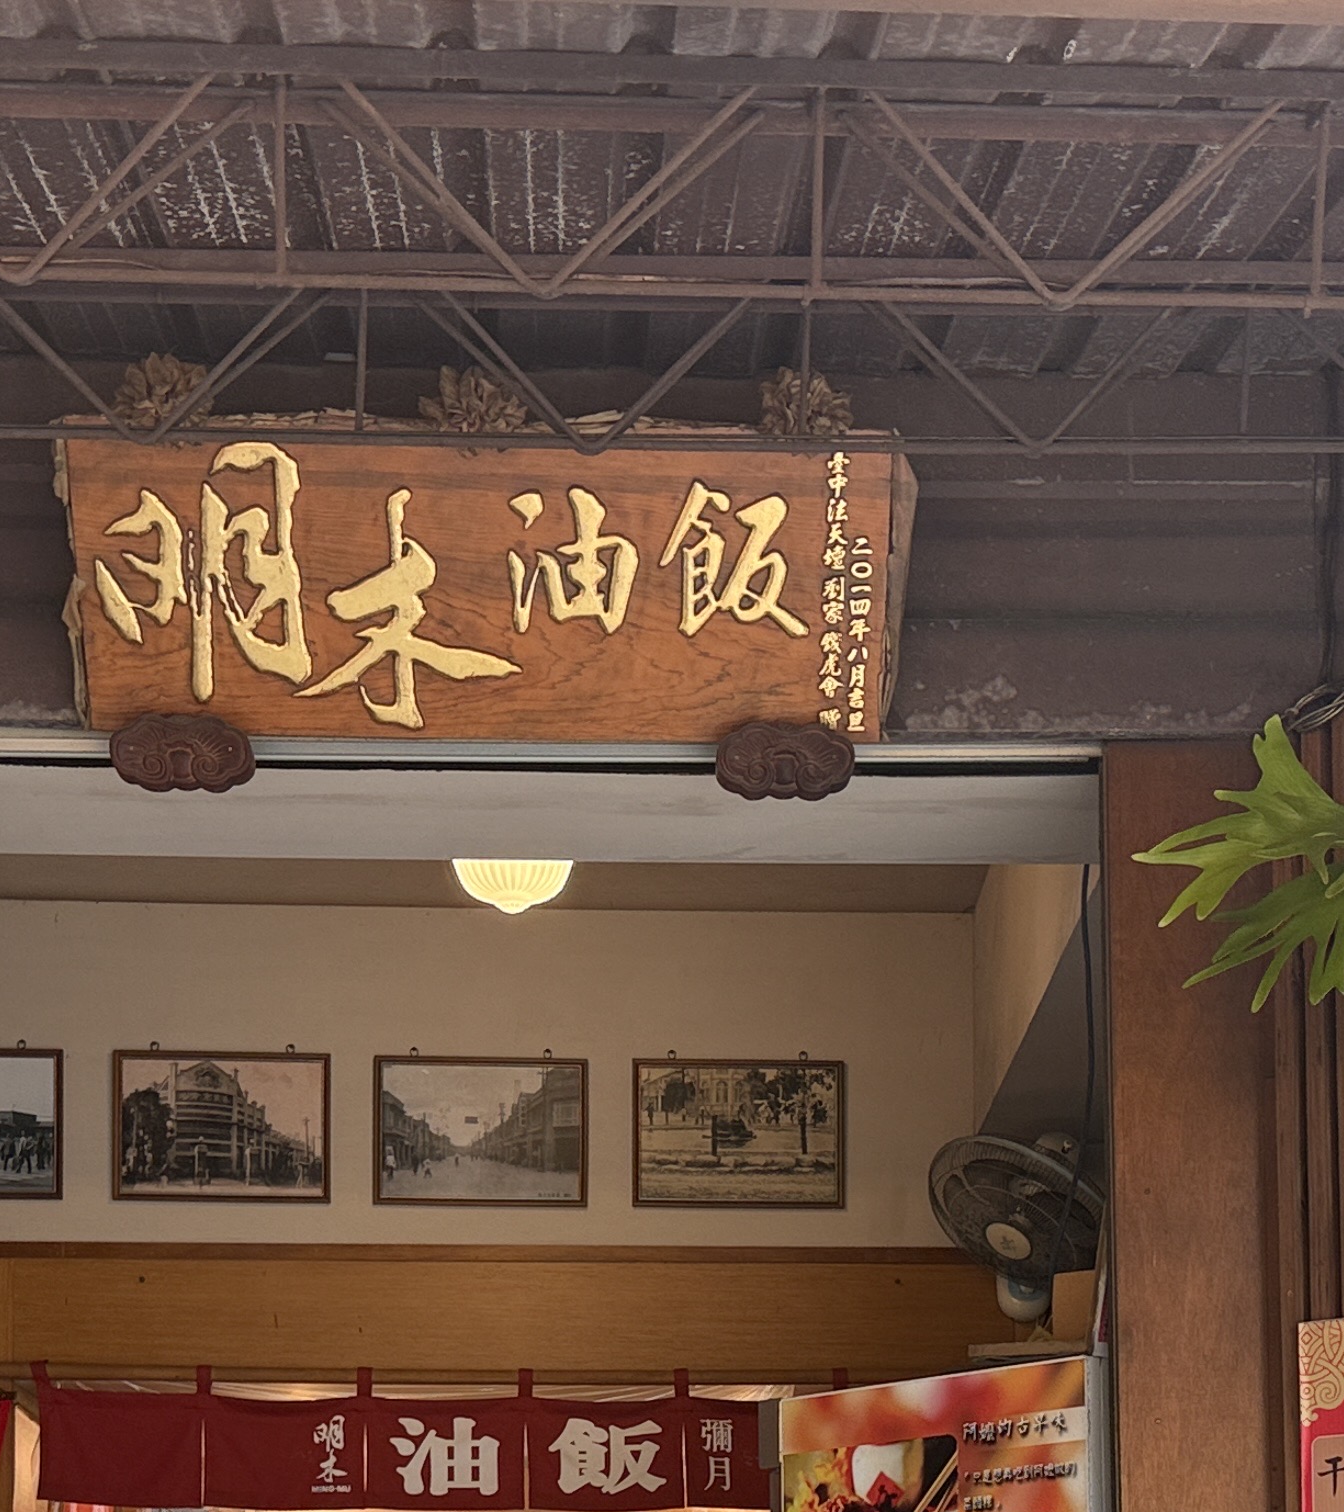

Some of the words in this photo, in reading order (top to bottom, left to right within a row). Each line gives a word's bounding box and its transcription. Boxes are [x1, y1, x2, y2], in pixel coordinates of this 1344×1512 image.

[96, 441, 810, 729] 明木油飯
[390, 1417, 667, 1496] 油飯
[700, 1418, 733, 1492] 彌月
